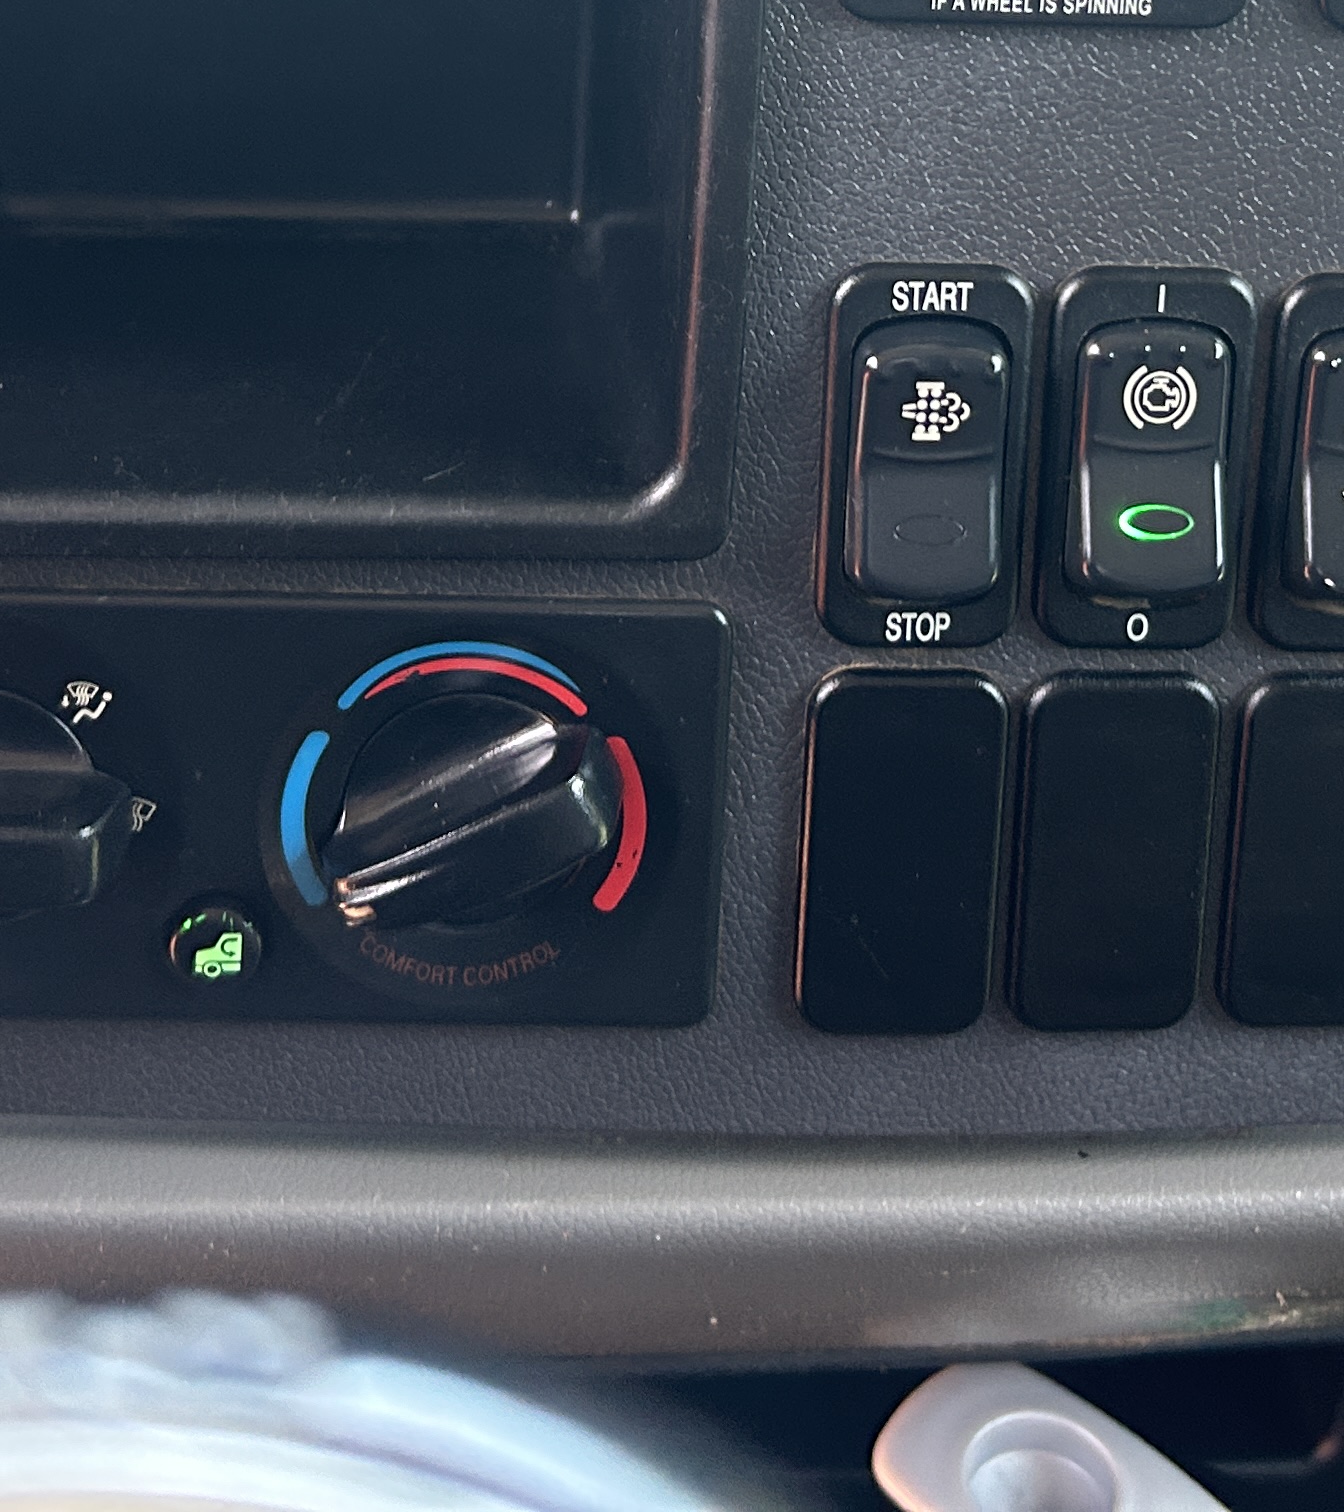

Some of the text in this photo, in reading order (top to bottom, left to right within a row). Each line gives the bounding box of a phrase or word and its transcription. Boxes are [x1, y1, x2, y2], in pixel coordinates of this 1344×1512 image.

[891, 281, 974, 311] START
[885, 612, 951, 642] STOP
[360, 934, 561, 986] COMFORT CONTROL
